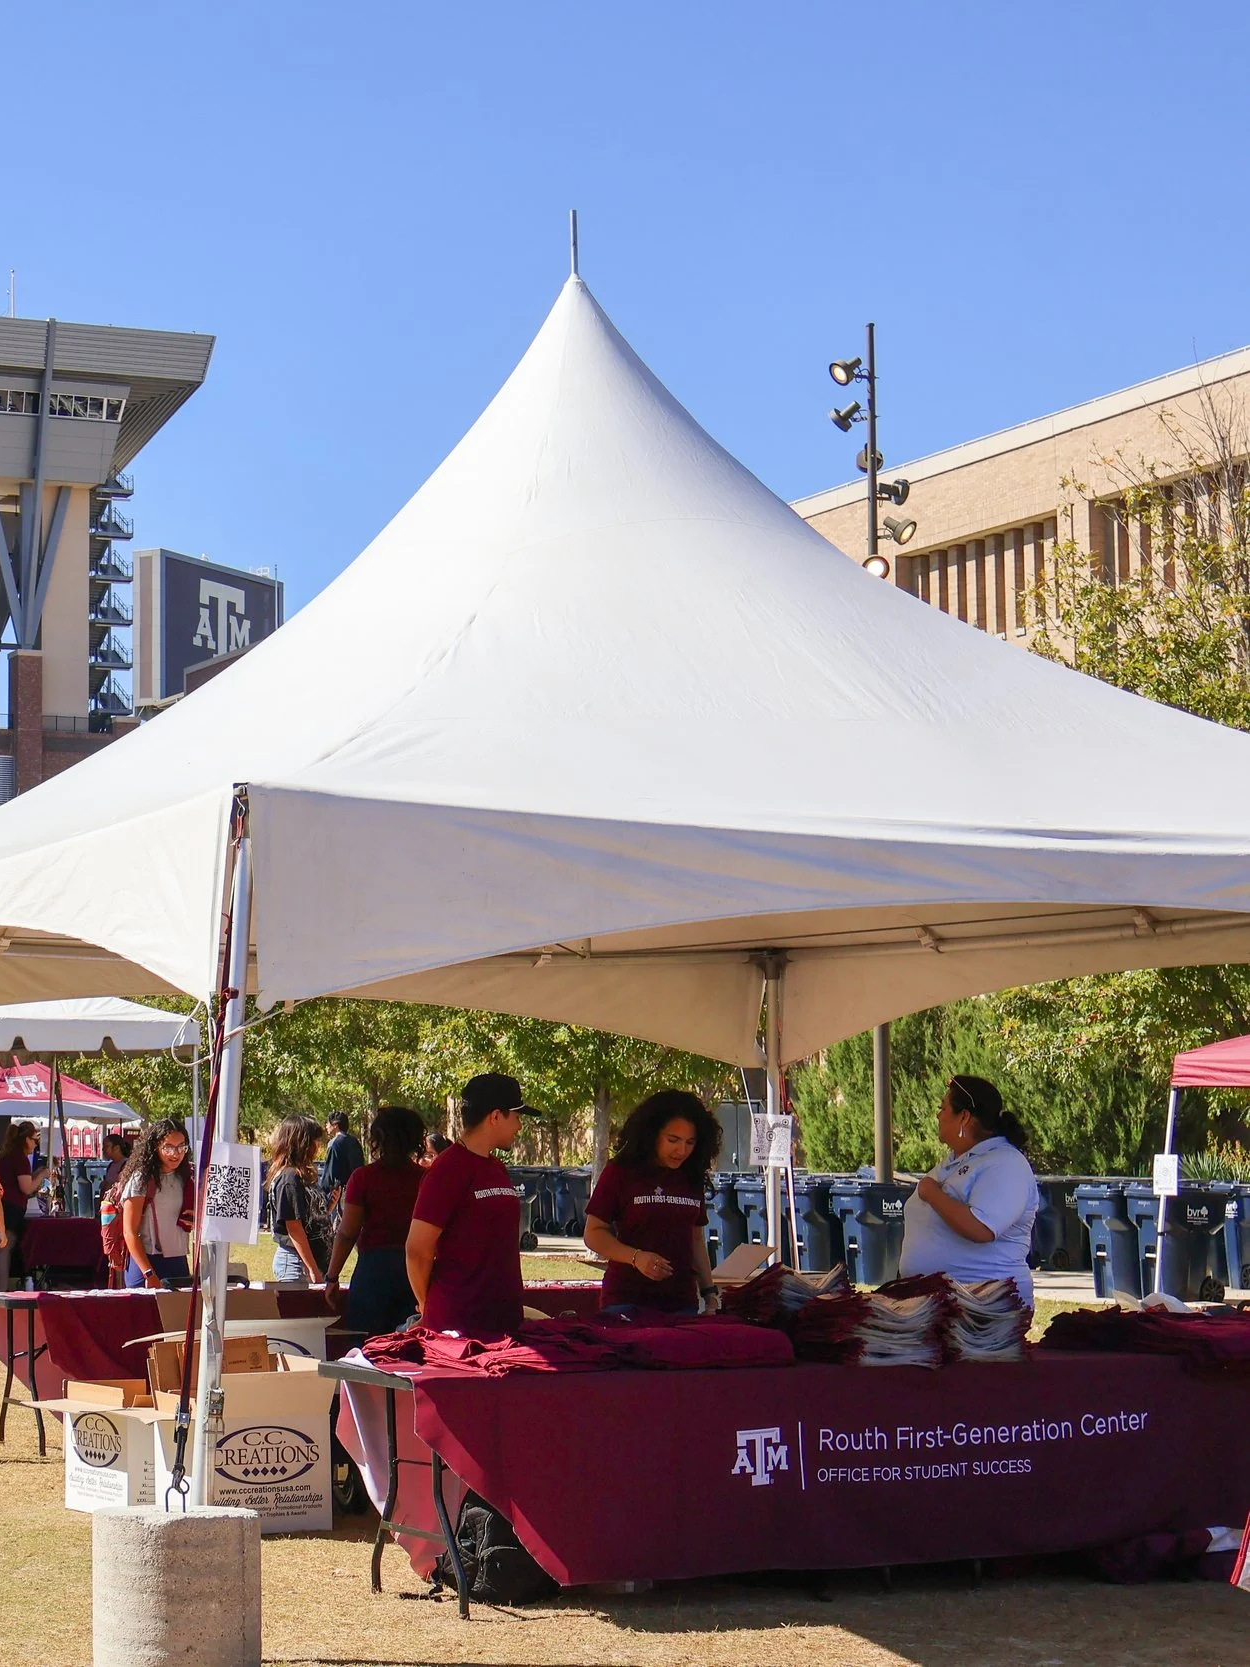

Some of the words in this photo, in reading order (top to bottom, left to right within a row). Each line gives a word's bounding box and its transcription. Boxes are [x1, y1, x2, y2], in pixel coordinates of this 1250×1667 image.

[5, 1074, 48, 1098] ATM
[633, 1195, 651, 1205] ROUTH
[882, 1199, 895, 1210] bvr
[1186, 1205, 1201, 1217] bvr
[85, 1417, 106, 1431] C.C.
[819, 1426, 888, 1451] Routh
[896, 1418, 1073, 1449] First-Generation
[1080, 1406, 1148, 1437] Center
[71, 1429, 122, 1453] CREATIONS
[242, 1431, 286, 1446] C.C.
[731, 1426, 789, 1487] ATM
[817, 1467, 870, 1482] OFFICE
[873, 1466, 901, 1481] FOR
[904, 1462, 968, 1480] STUDENT
[972, 1459, 1032, 1476] SUCCESS
[219, 1484, 311, 1496] www.cccreationsusa.com
[213, 1497, 241, 1508] uilding
[245, 1494, 270, 1506] Better
[273, 1492, 324, 1507] Relationships
